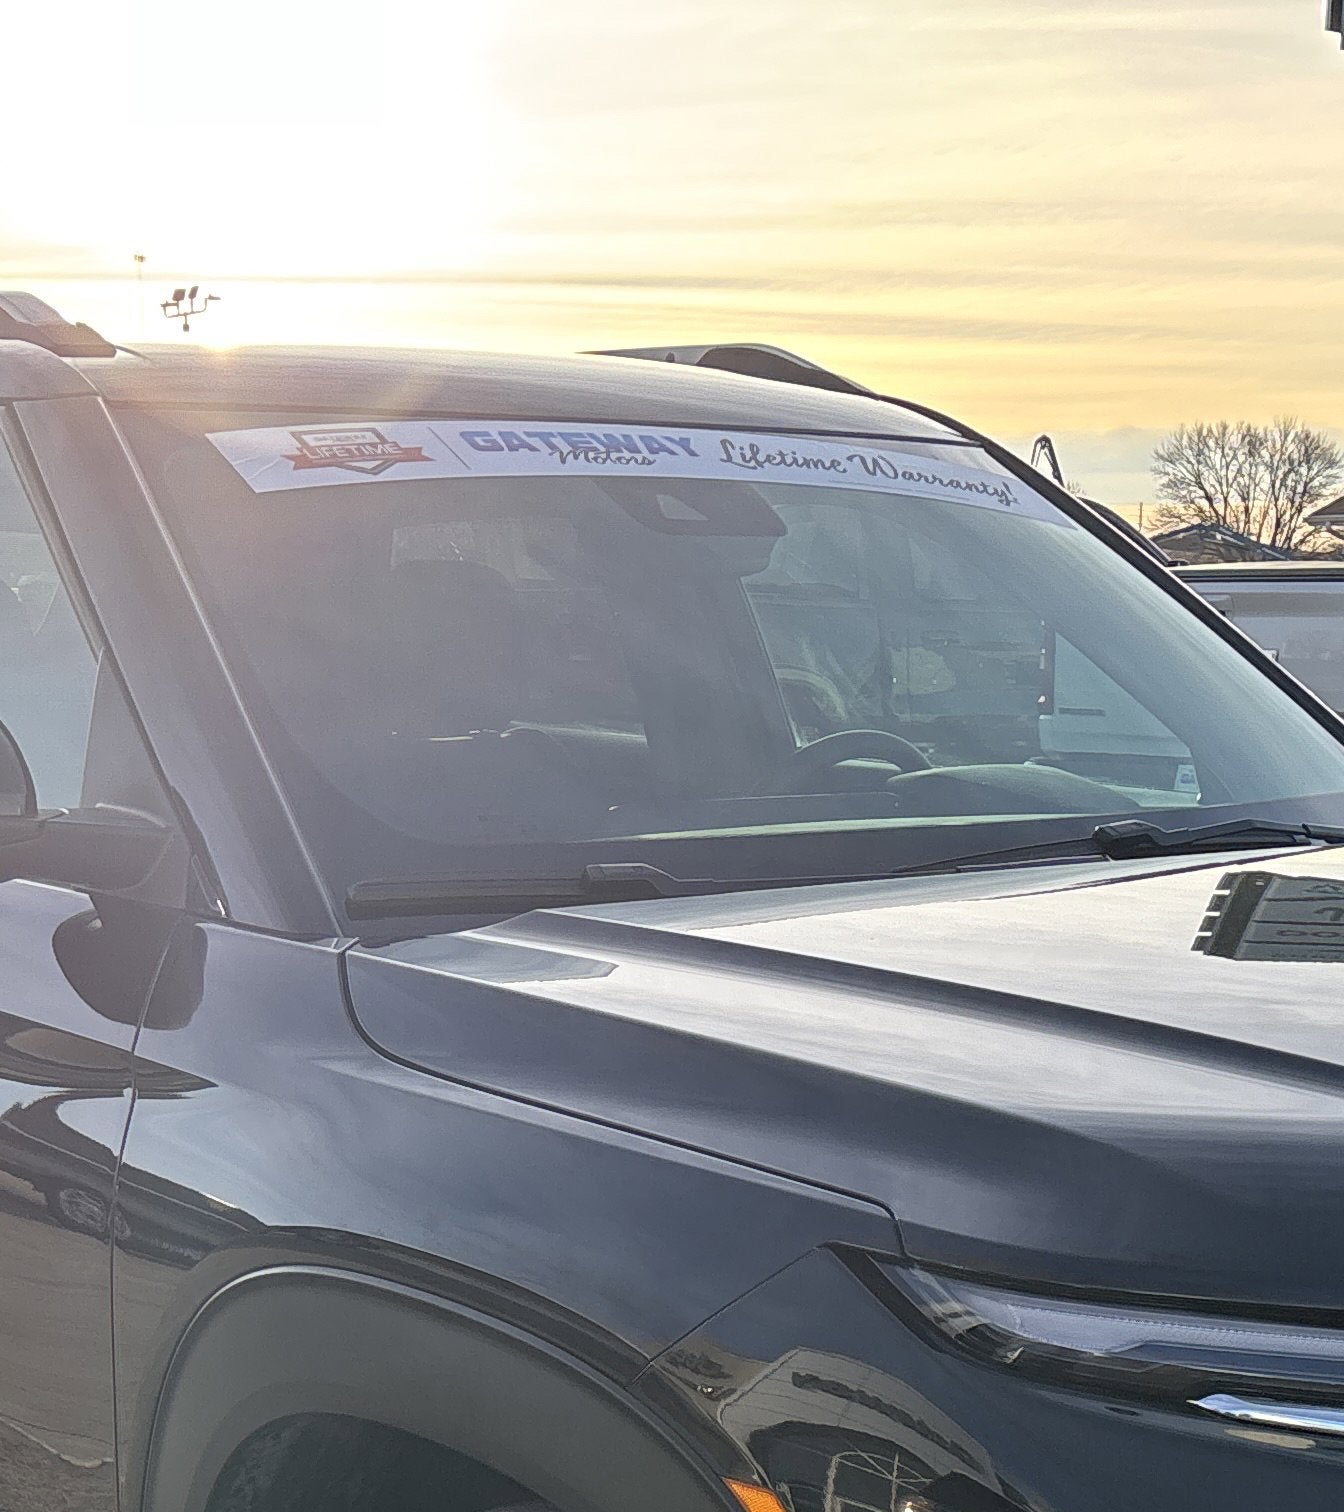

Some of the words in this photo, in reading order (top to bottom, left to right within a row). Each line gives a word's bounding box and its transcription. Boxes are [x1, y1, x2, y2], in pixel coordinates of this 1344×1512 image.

[302, 442, 403, 459] LIFETIME
[549, 448, 656, 466] Motors
[459, 430, 701, 458] GATEWAY
[719, 438, 847, 471] Lifetime
[846, 452, 1020, 506] Warranty!
